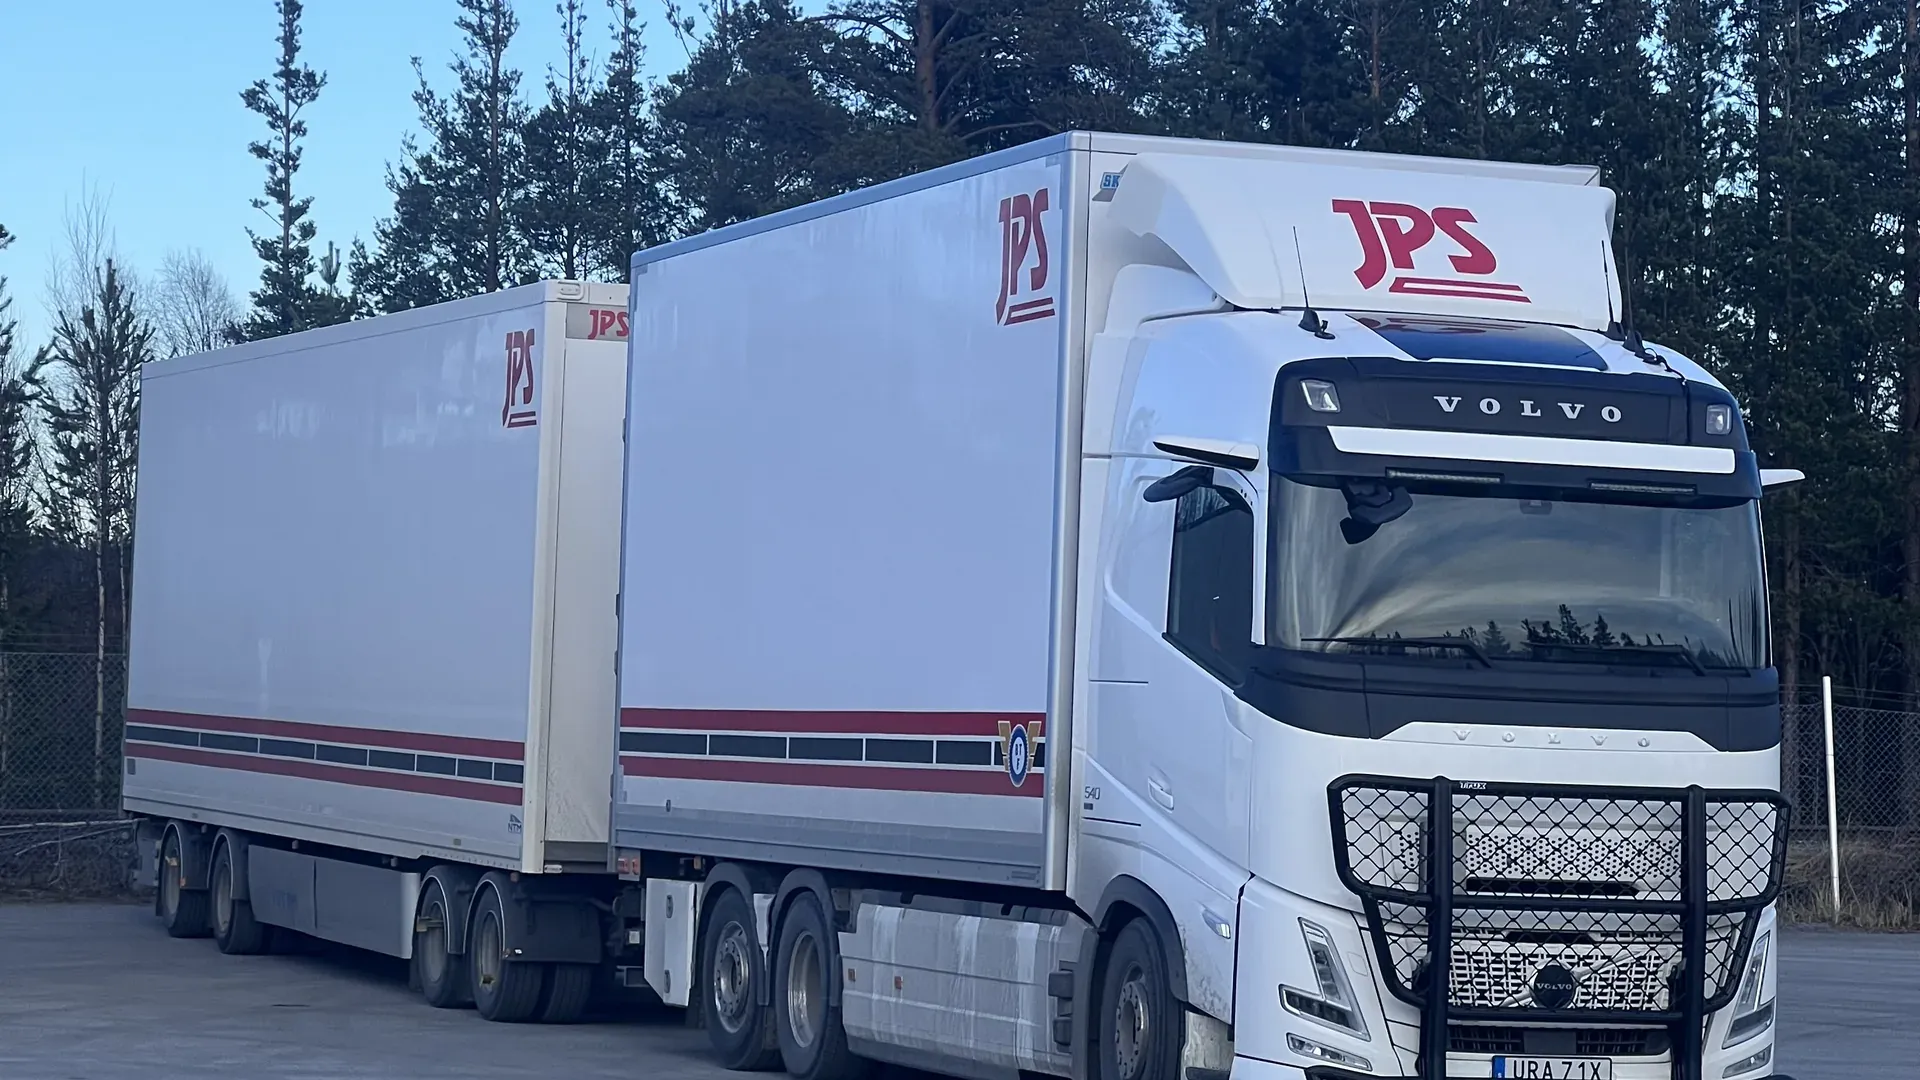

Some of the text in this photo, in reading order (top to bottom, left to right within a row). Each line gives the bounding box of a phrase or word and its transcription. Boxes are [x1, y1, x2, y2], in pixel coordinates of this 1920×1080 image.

[996, 187, 1049, 325] JPS
[1332, 199, 1498, 290] JPS
[587, 309, 630, 340] JPS
[502, 328, 535, 427] JPS
[1433, 395, 1622, 423] VOLVO
[1453, 730, 1651, 748] VOLVO
[1084, 786, 1101, 800] 540
[507, 823, 522, 834] NTM
[1513, 1060, 1601, 1080] URA 71X
